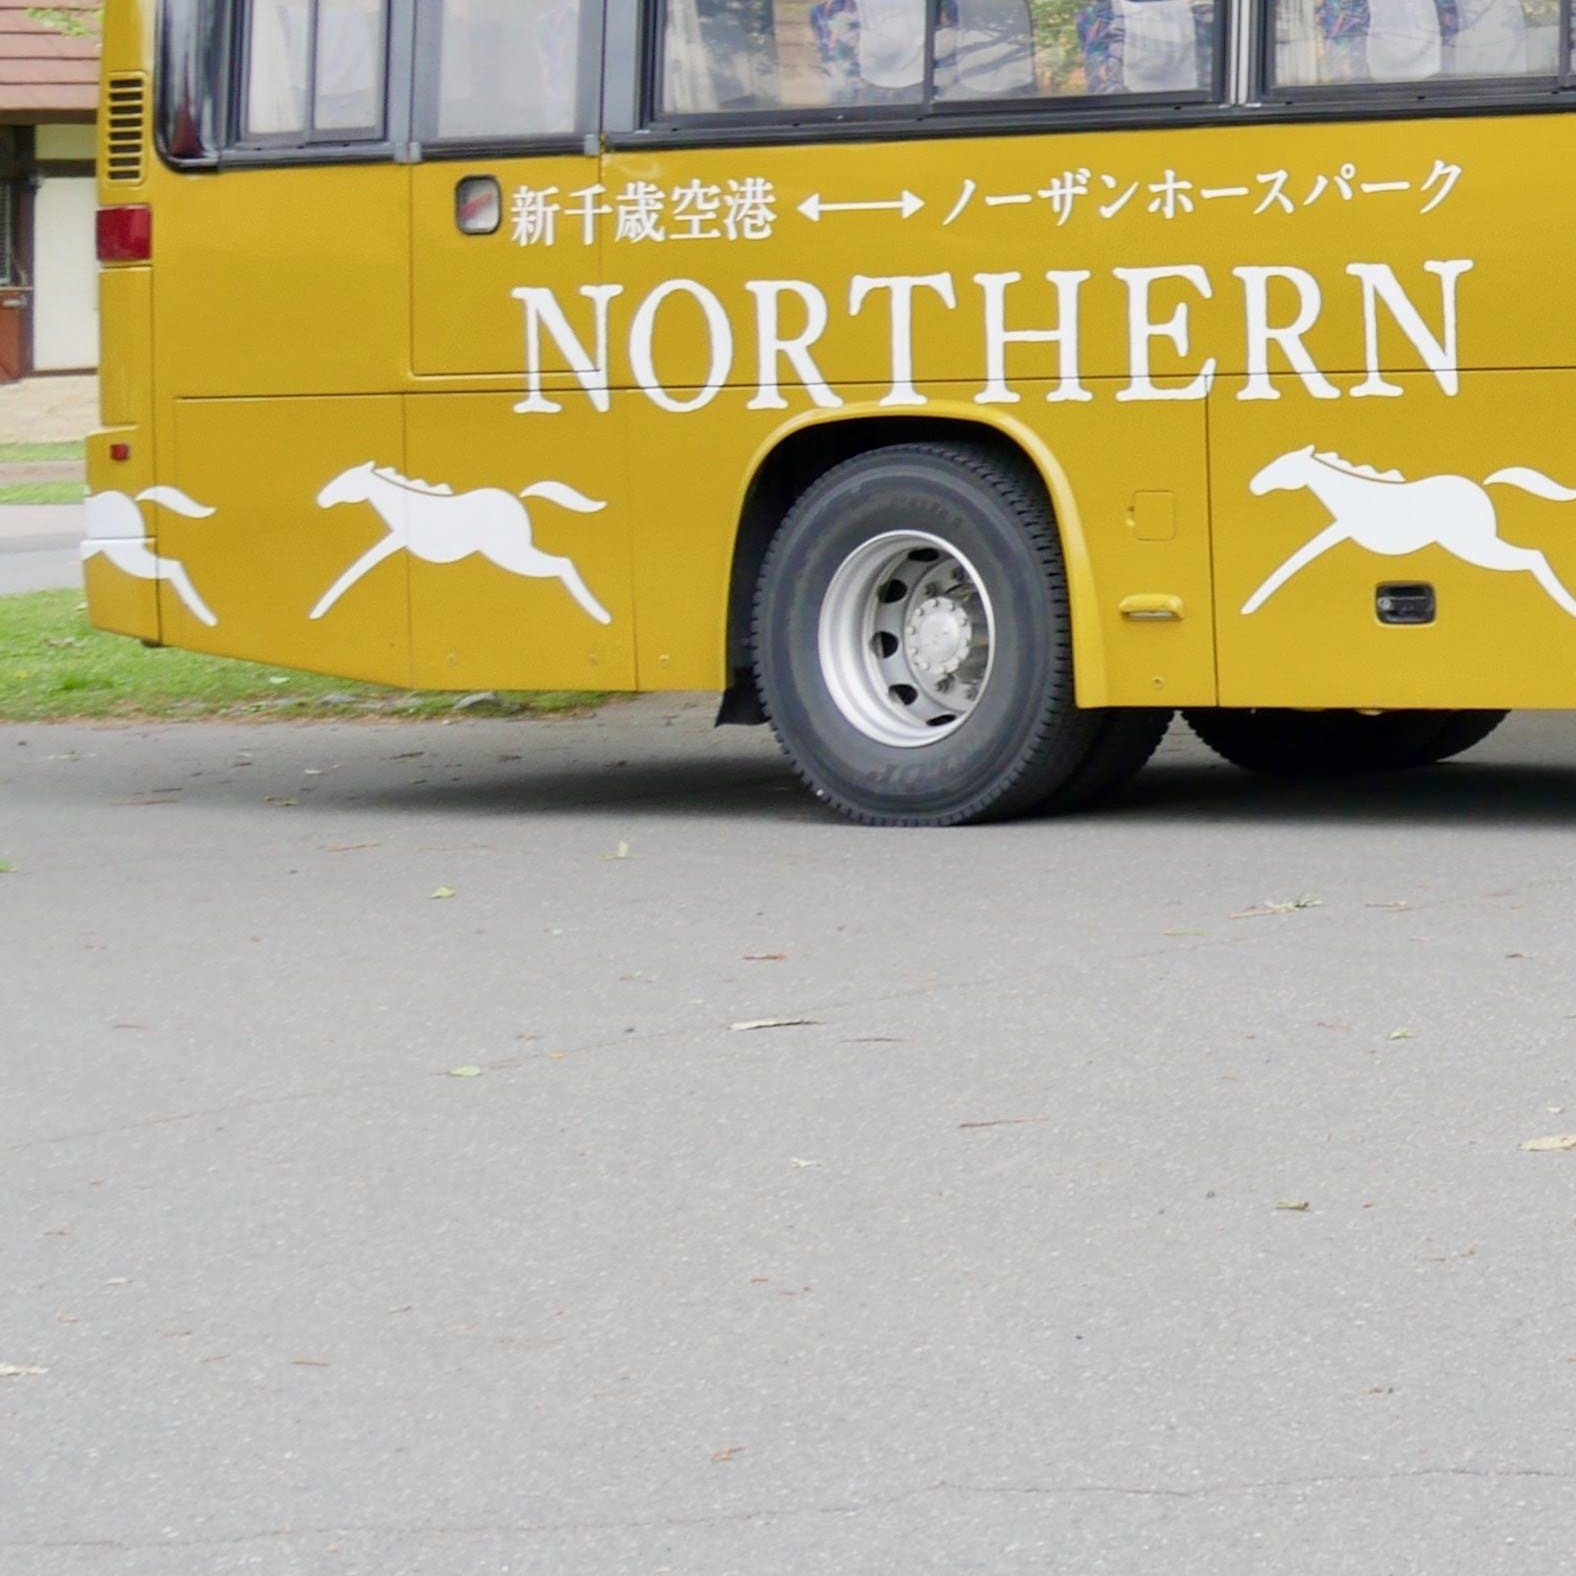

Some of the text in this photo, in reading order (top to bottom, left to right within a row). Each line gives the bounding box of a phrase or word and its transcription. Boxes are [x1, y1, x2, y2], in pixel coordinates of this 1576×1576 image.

[511, 159, 1463, 246] 新千歳空港 ノーザンホースパーク
[511, 259, 1474, 413] NORTHERN
